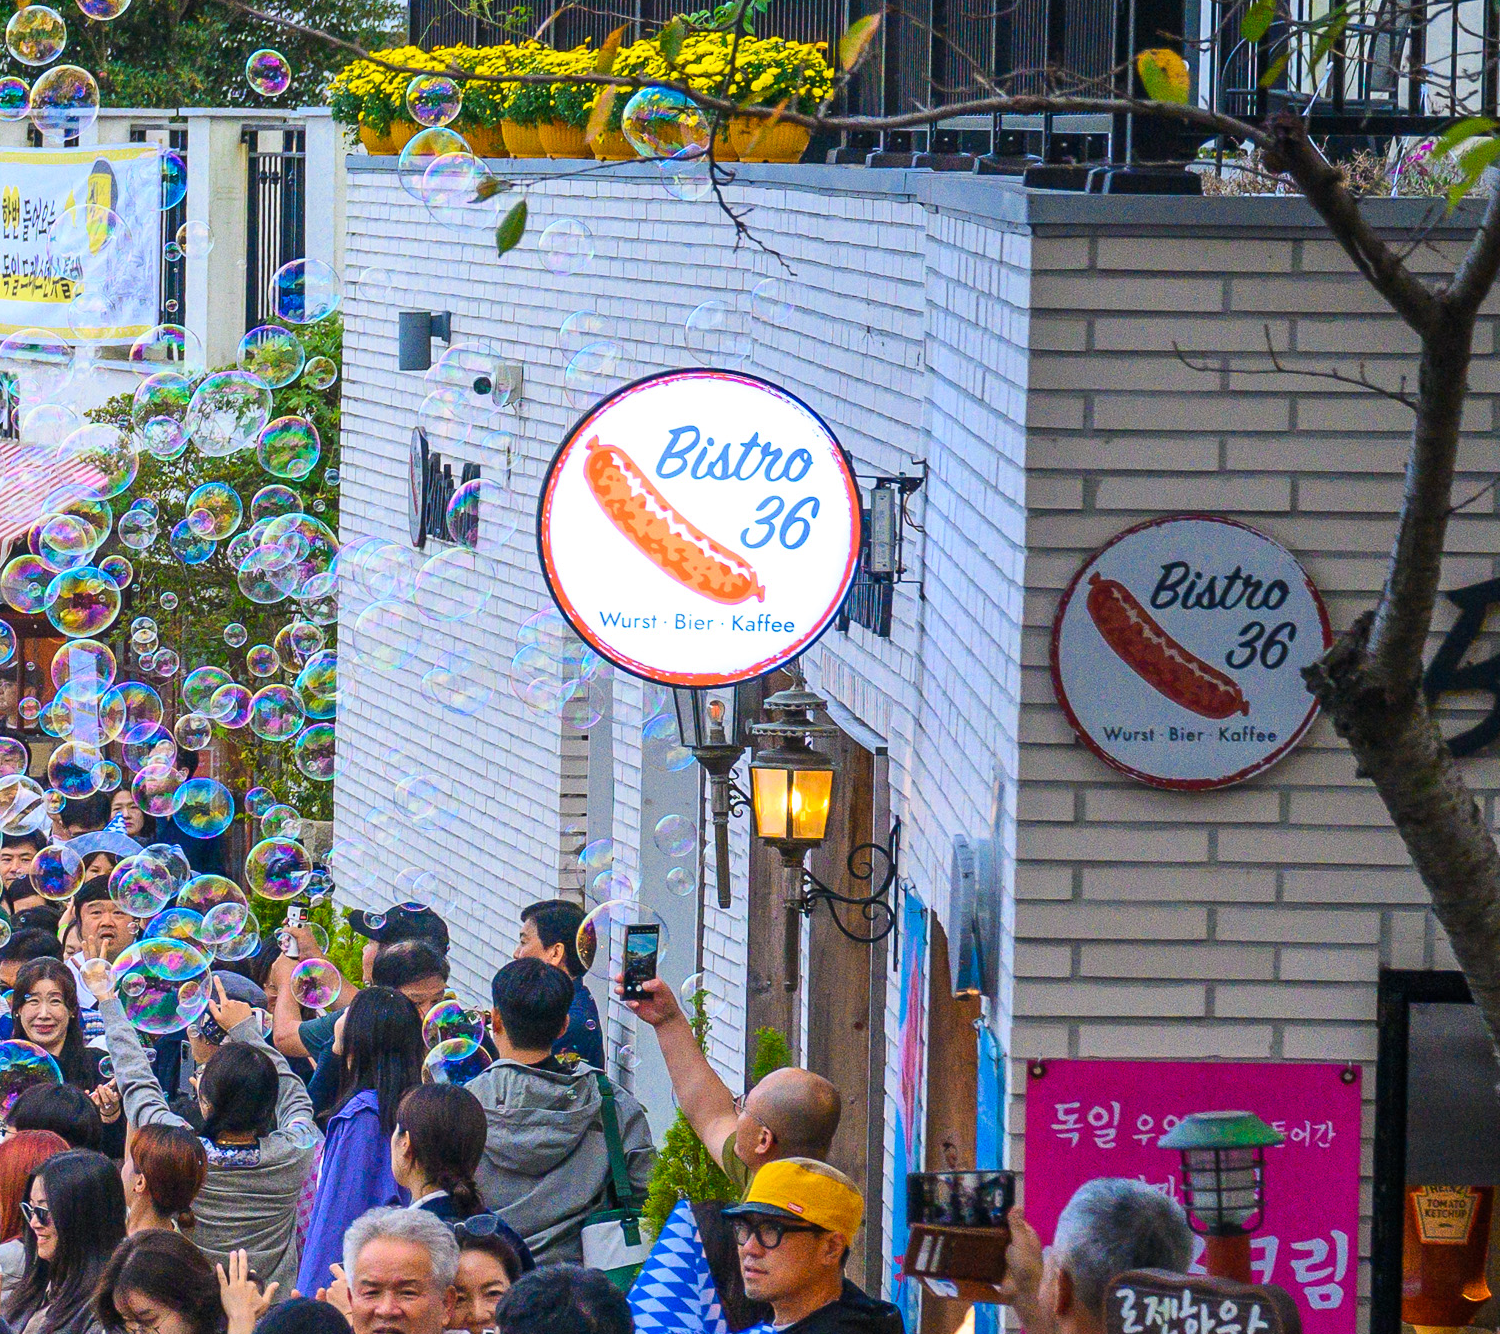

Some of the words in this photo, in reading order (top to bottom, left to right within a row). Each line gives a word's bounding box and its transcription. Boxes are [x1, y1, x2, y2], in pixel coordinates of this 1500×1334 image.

[655, 425, 815, 483] Bistro
[741, 496, 820, 550] 36
[1150, 561, 1290, 612] Bistro
[599, 611, 658, 630] Wurst
[674, 612, 713, 631] Bier
[731, 613, 795, 633] Kaffee
[1225, 622, 1298, 670] 36
[1103, 726, 1155, 743] Wurst
[1168, 726, 1205, 742] Bier
[1219, 726, 1278, 744] Kaffee
[1051, 1101, 1121, 1148] 독일
[1424, 1209, 1468, 1219] KETCHUP
[1426, 1198, 1466, 1209] TOMATO
